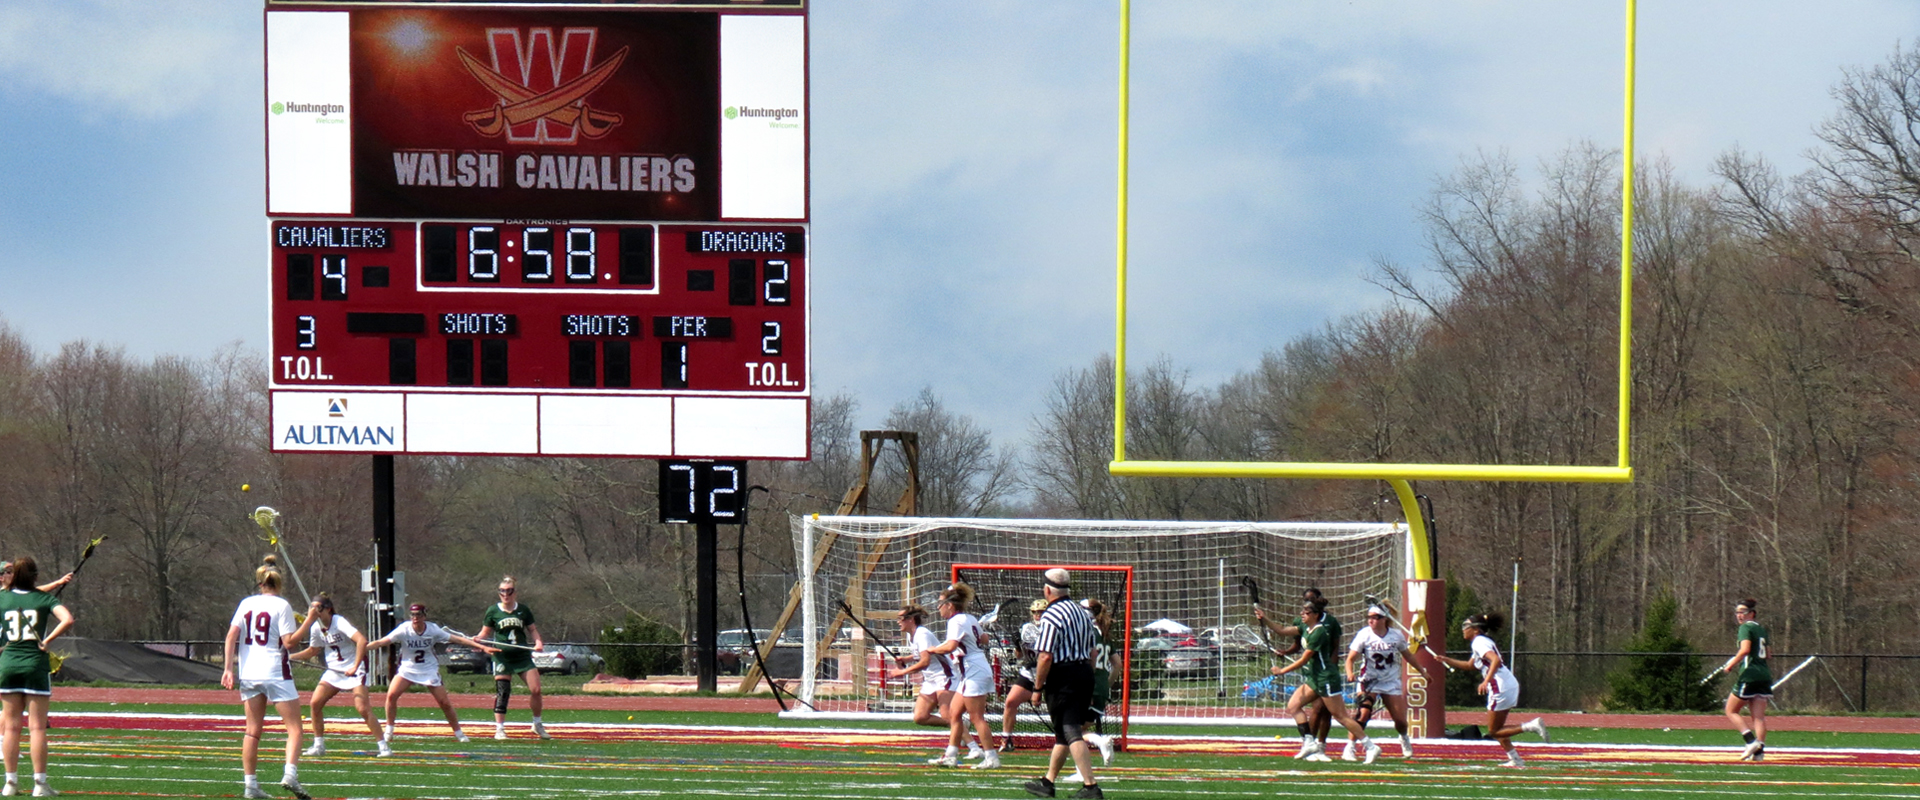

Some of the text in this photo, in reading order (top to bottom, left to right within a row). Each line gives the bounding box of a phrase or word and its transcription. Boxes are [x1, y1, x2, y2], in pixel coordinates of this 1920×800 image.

[286, 101, 344, 116] Huntington
[739, 106, 799, 121] Huntington
[393, 152, 696, 193] WALSH CAVALIERS
[278, 226, 386, 248] CAVALIERS
[701, 231, 786, 252] DRAGONS
[322, 257, 346, 294] 4
[764, 260, 789, 303] 2
[299, 315, 316, 348] 3
[444, 313, 507, 334] SHOTS
[567, 314, 629, 336] SHOTS
[671, 316, 707, 337] PER
[762, 321, 781, 354] 2
[280, 356, 334, 380] T.O.L.
[680, 344, 687, 382] 1
[745, 362, 799, 386] T.O.L.
[283, 424, 394, 445] AULTMAN
[669, 464, 738, 517] 72
[4, 609, 38, 641] 32
[243, 610, 271, 646] 19
[497, 617, 523, 629] TIFFIN
[508, 630, 517, 645] 4
[1758, 637, 1767, 658] 6
[414, 649, 425, 663] 2
[1371, 652, 1394, 670] 24
